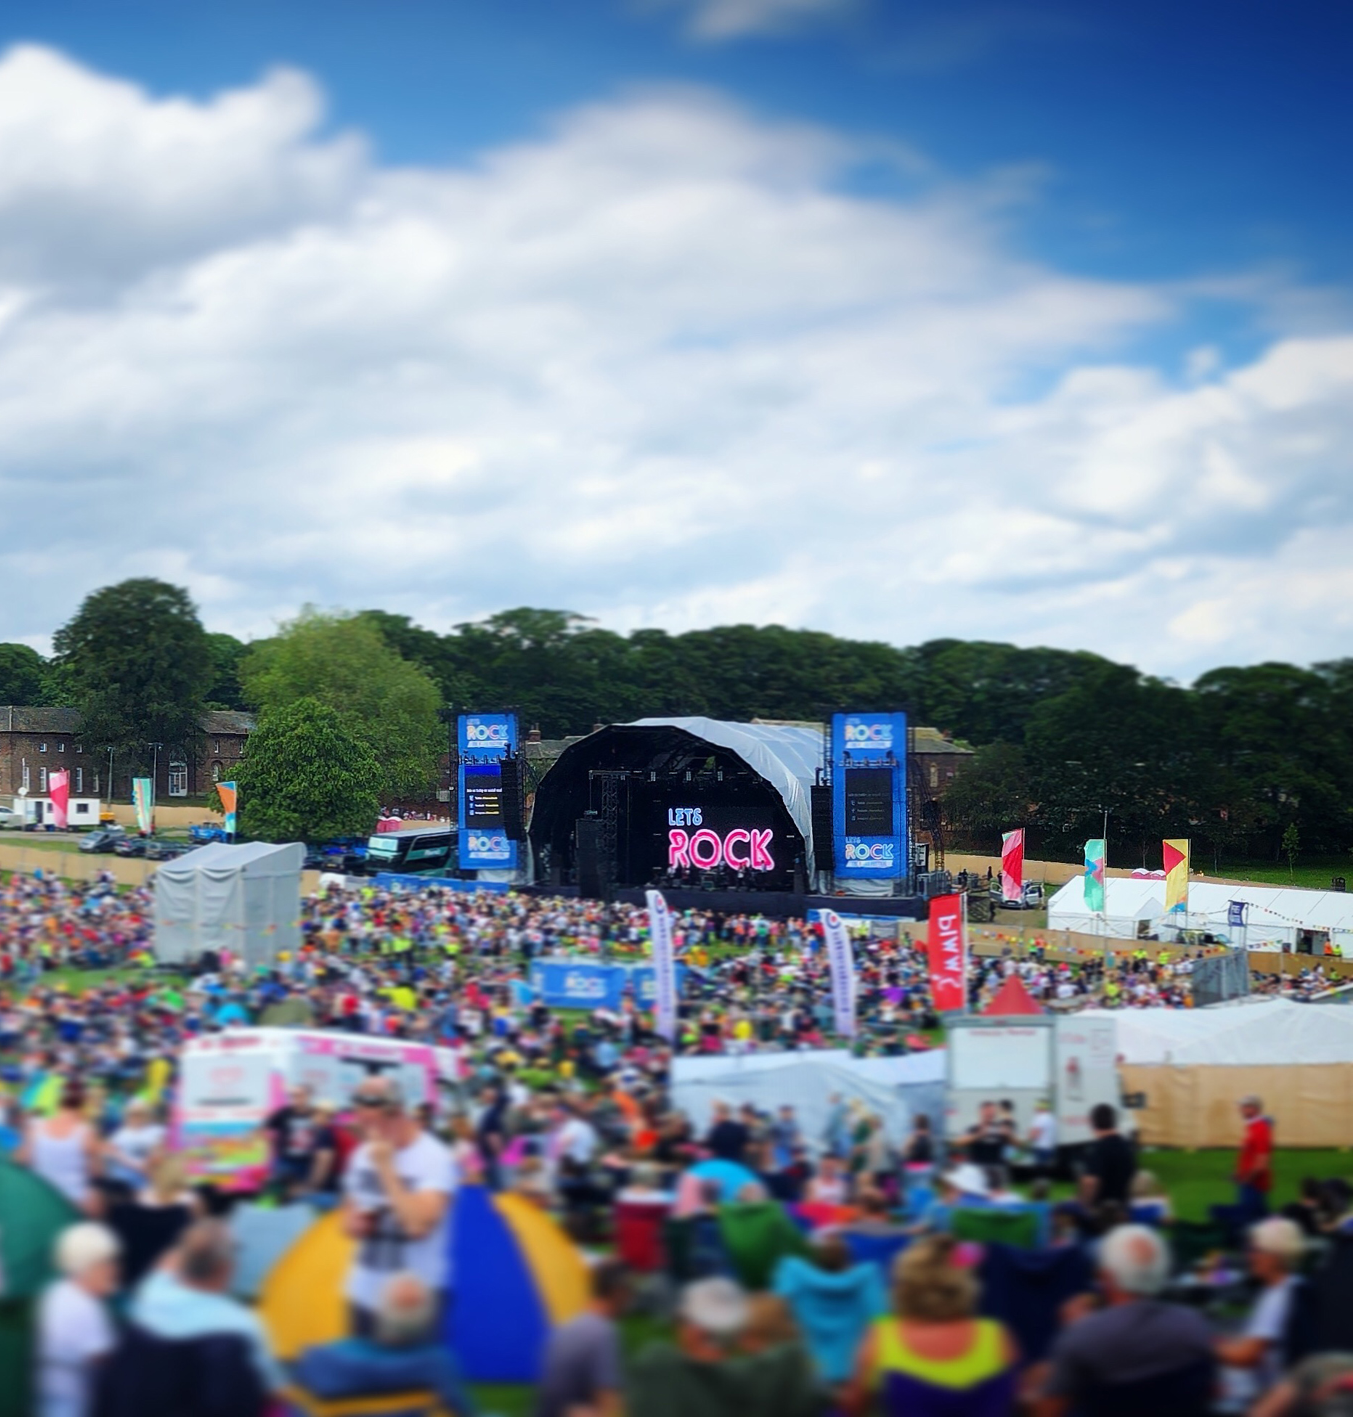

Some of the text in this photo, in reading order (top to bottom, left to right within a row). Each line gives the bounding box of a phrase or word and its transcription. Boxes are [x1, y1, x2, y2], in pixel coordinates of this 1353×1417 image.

[467, 725, 509, 740] ROCK
[844, 724, 893, 740] ROCK
[668, 808, 703, 826] LETS
[468, 836, 511, 851] ROCK
[668, 829, 775, 870] ROCK
[845, 844, 894, 859] ROCK
